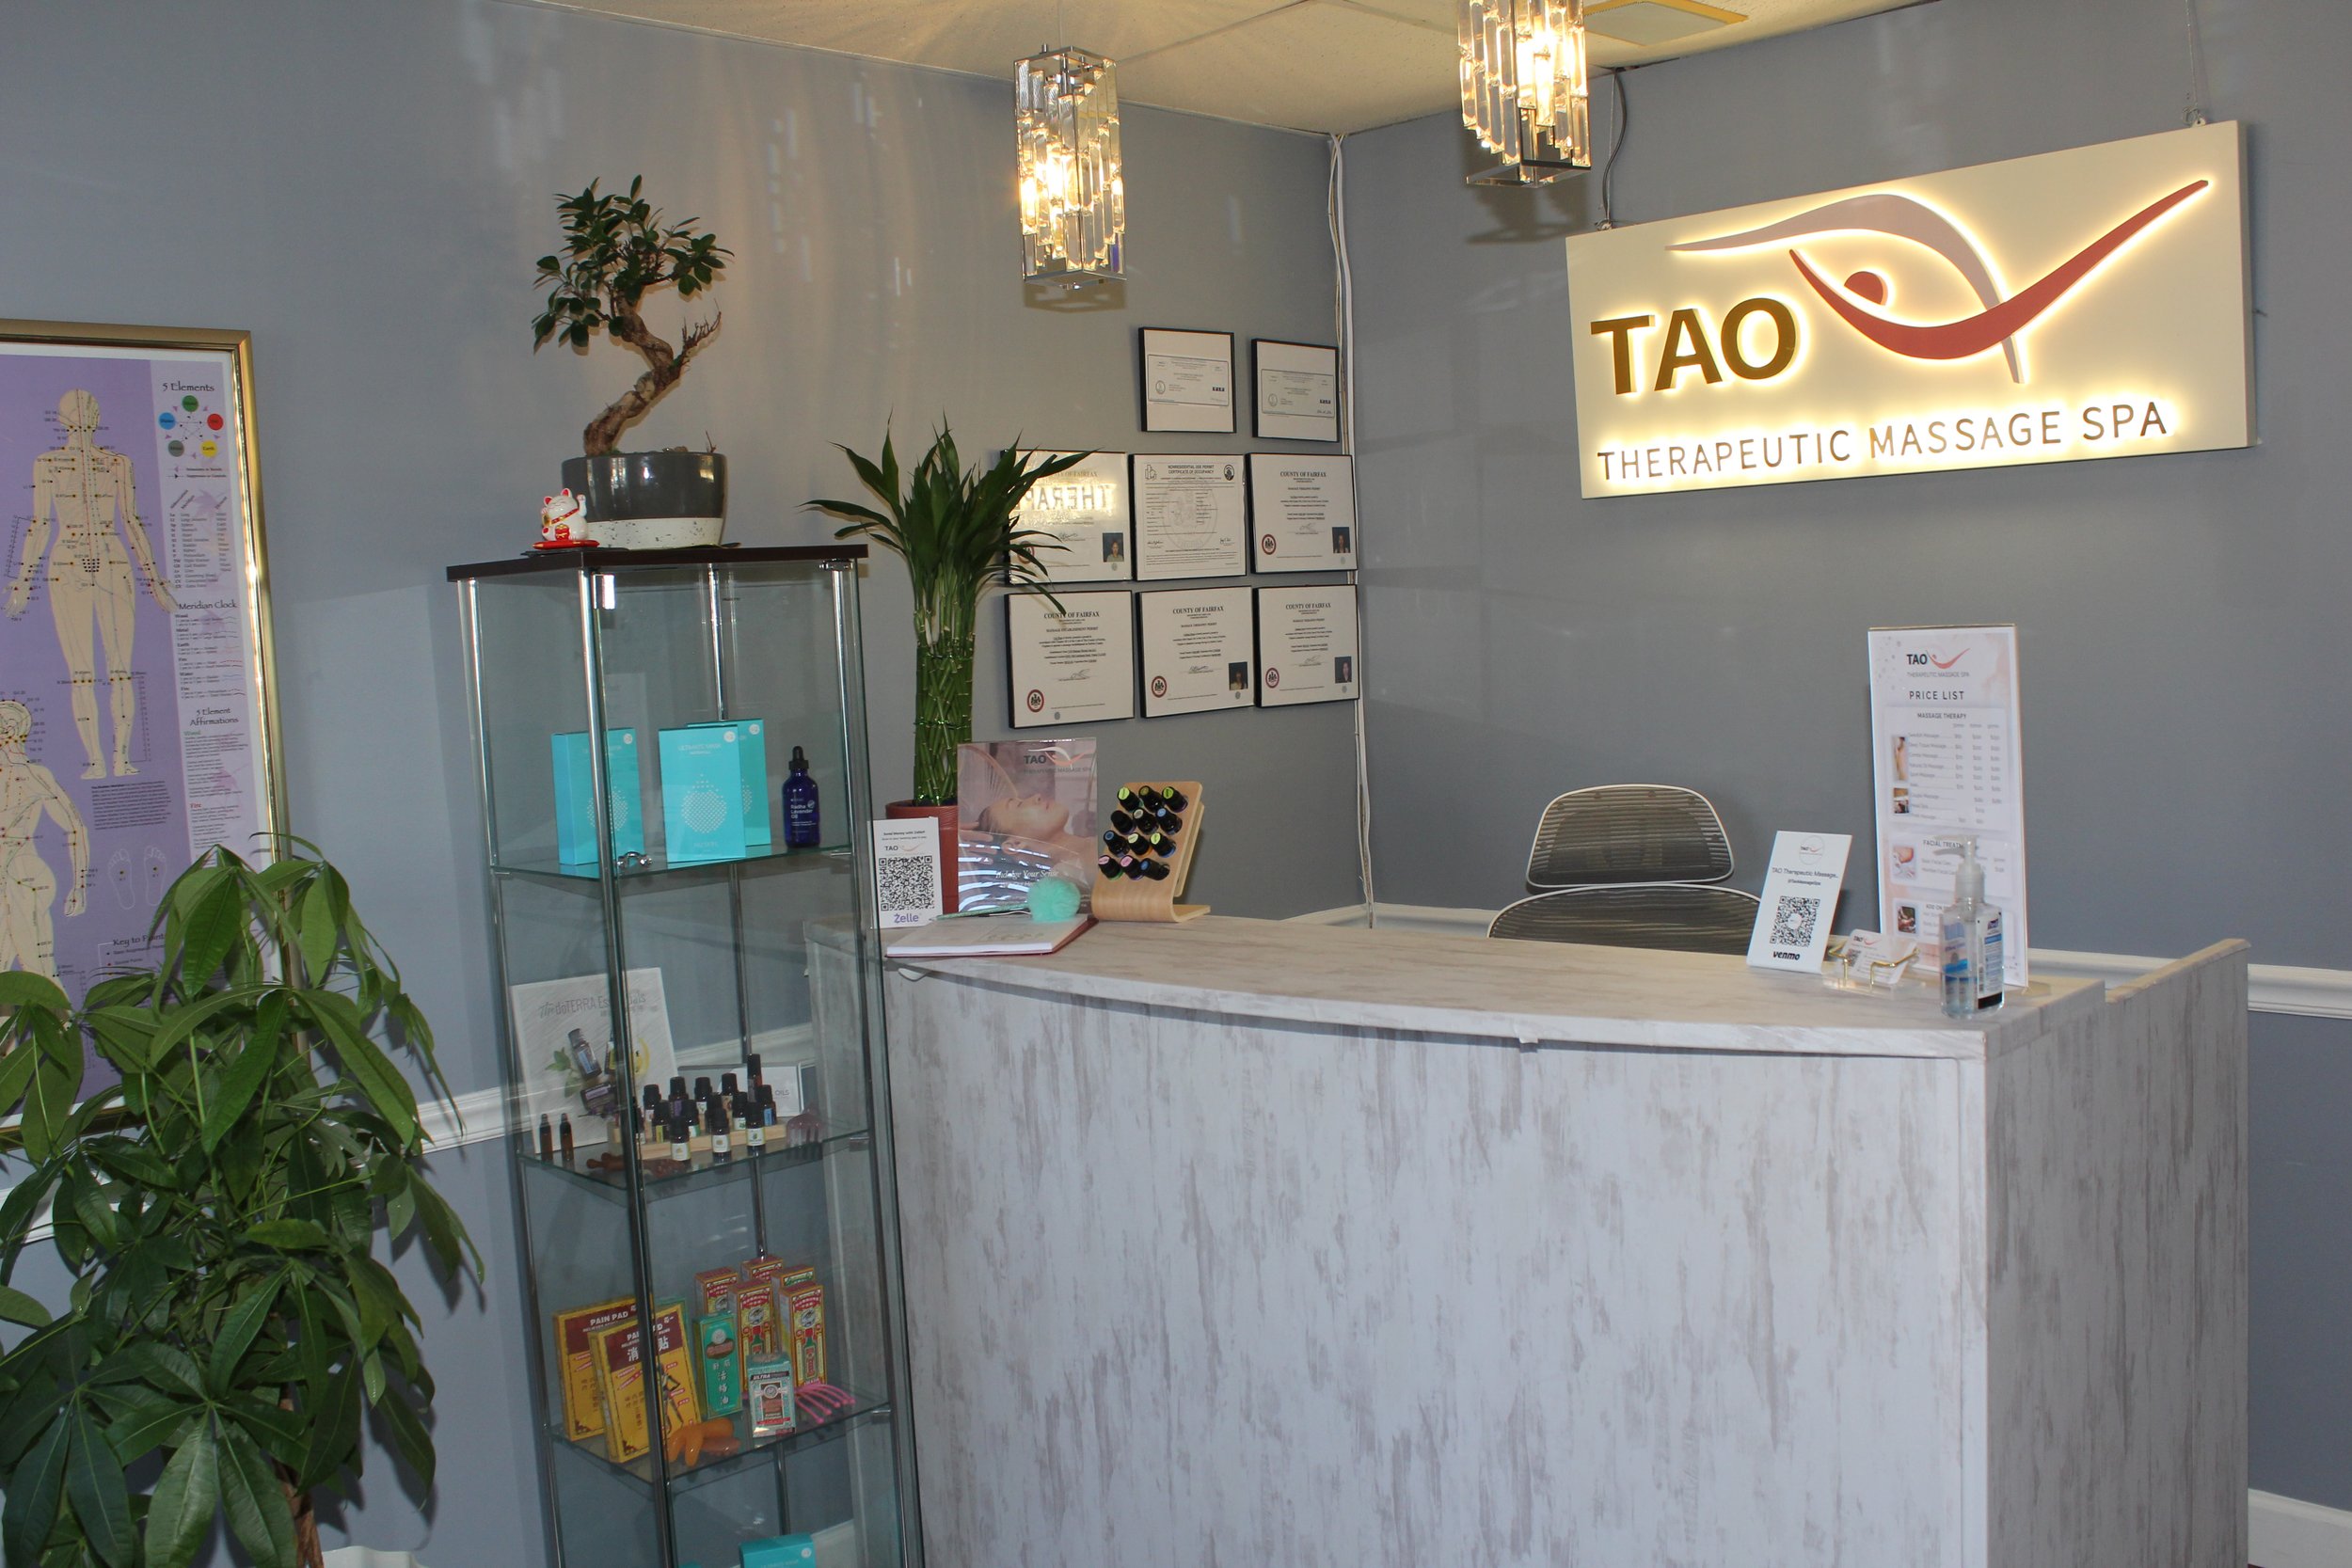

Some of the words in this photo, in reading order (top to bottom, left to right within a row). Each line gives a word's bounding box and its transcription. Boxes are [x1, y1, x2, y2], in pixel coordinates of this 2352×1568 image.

[1590, 298, 1798, 396] TAO
[162, 383, 168, 391] 5
[171, 381, 215, 391] Elements
[1597, 429, 1851, 483] THERAPEUTIC
[1869, 410, 2062, 460] MASSAGE
[2082, 401, 2167, 440] SPA
[179, 601, 214, 610] Meridian
[215, 599, 237, 609] Clock
[1906, 654, 1928, 665] TAO
[1909, 690, 1938, 700] PRICE
[1943, 690, 1964, 700] LIST
[202, 707, 230, 716] Element
[190, 717, 239, 726] Affirmations
[1024, 755, 1047, 764] TAO
[1784, 868, 1813, 877] Therapeutic
[894, 913, 919, 924] Zelle
[113, 939, 130, 948] Key
[1772, 950, 1801, 961] venmo
[590, 1315, 611, 1326] PAIN
[612, 1311, 629, 1321] PAD
[627, 1333, 640, 1341] PAI
